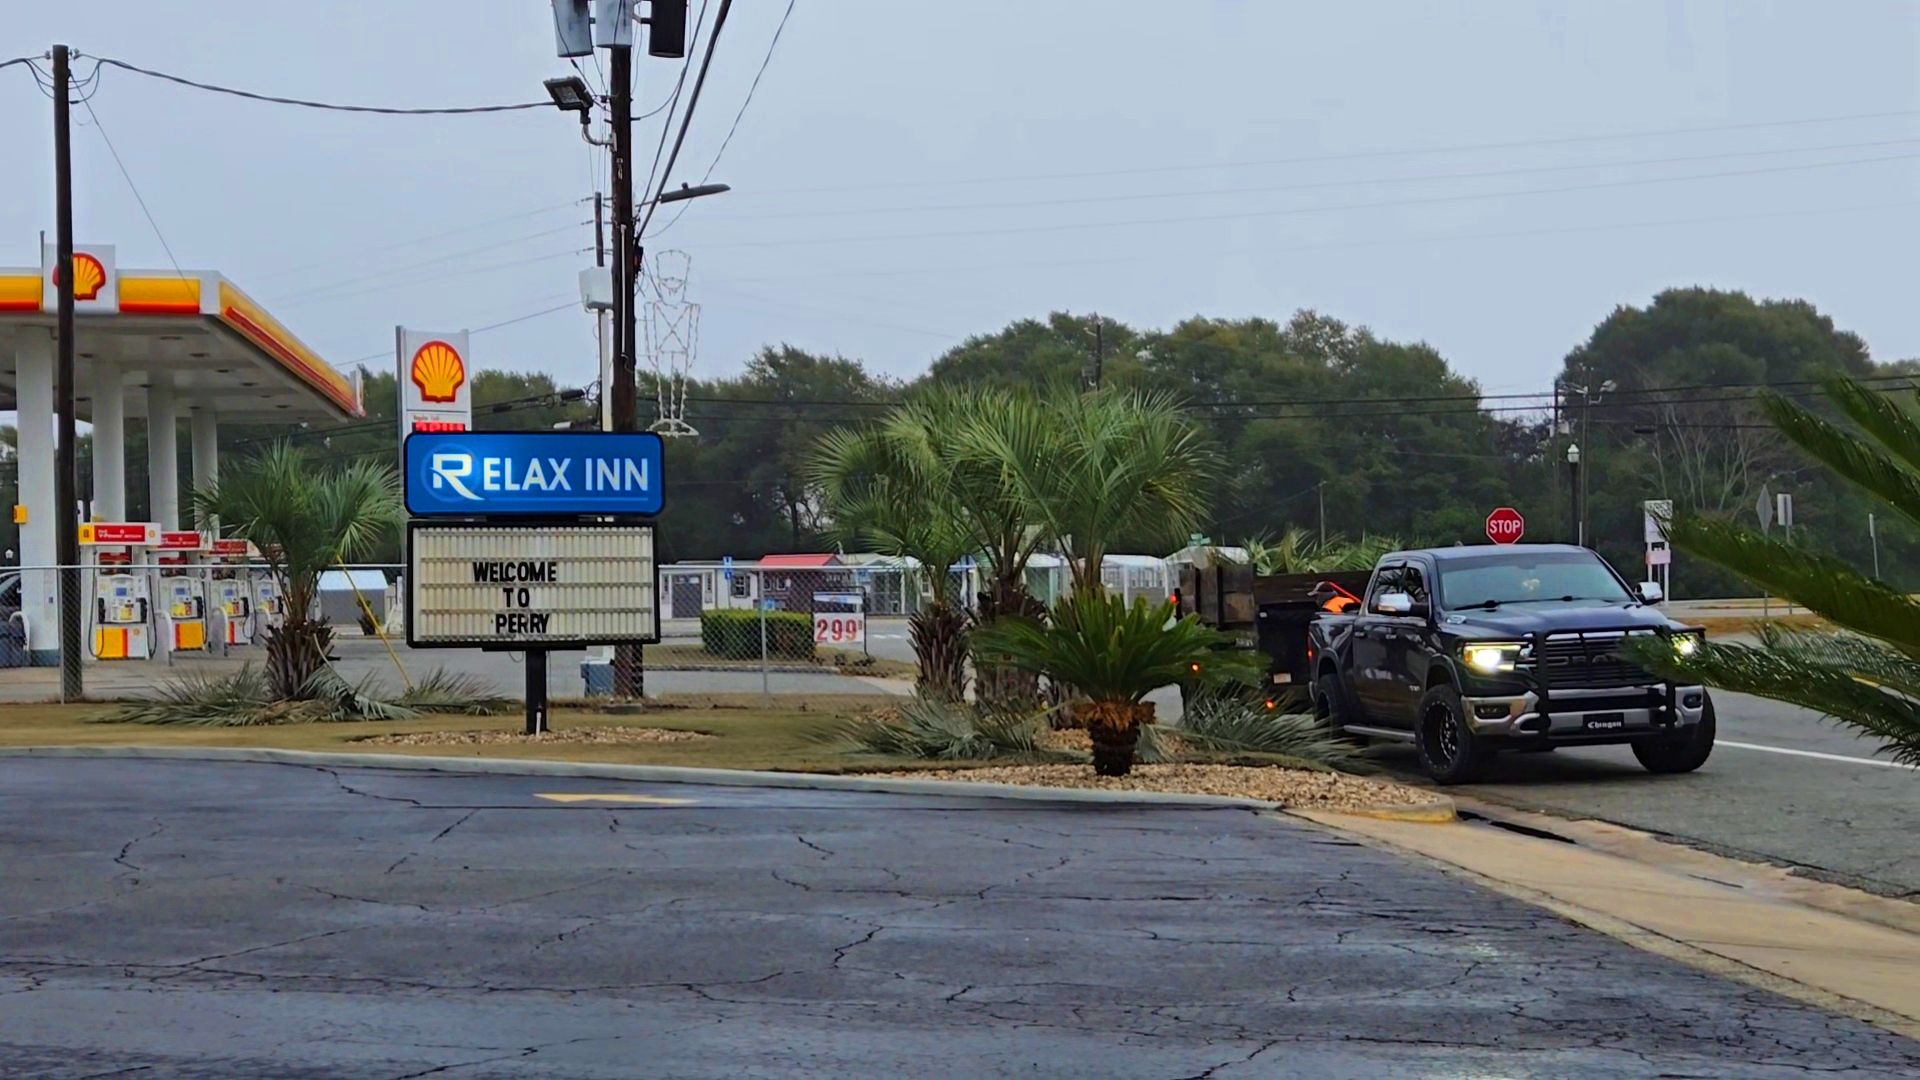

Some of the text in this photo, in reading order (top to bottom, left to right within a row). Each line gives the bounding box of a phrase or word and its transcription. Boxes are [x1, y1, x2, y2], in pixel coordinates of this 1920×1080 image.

[431, 453, 648, 501] RELAX INN
[1490, 519, 1521, 534] STOP
[473, 561, 557, 582] WELCOME
[503, 587, 530, 608] TO
[495, 613, 550, 634] PERRY
